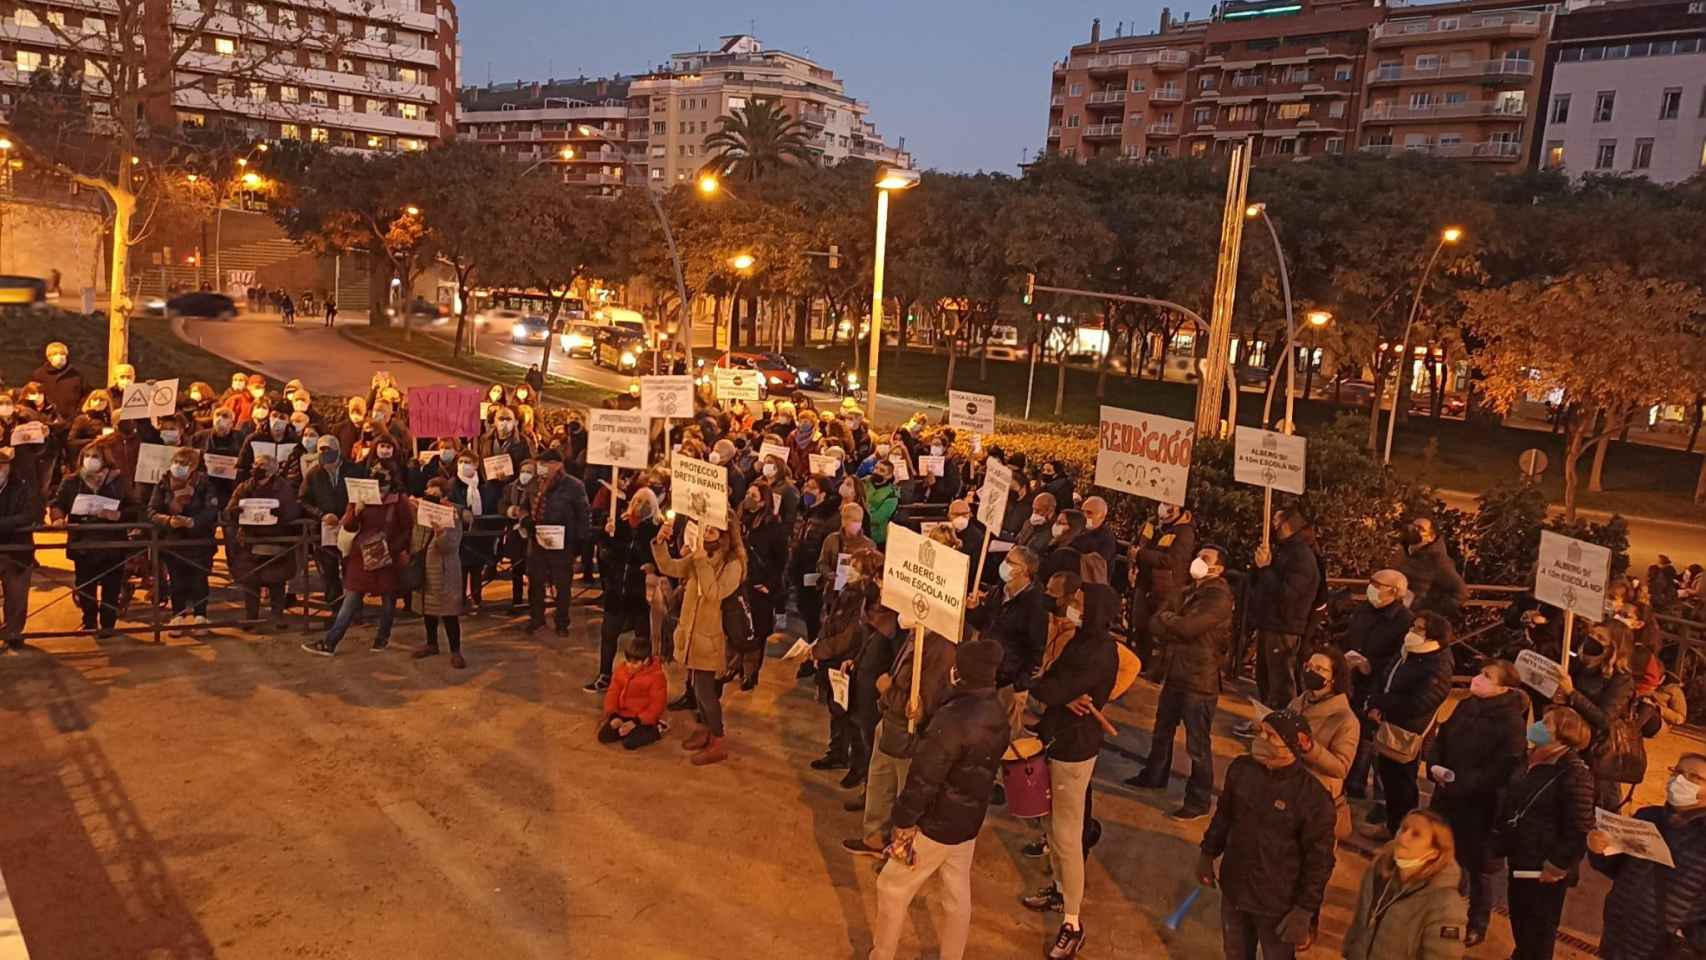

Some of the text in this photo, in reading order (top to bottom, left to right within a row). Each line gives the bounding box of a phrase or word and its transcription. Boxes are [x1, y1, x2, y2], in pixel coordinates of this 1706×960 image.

[674, 470, 725, 493] DRETS INFANTS
[902, 560, 935, 581] ALBERG
[888, 567, 894, 576] A
[911, 577, 943, 601] ESCOLA
[944, 594, 960, 608] NO!
